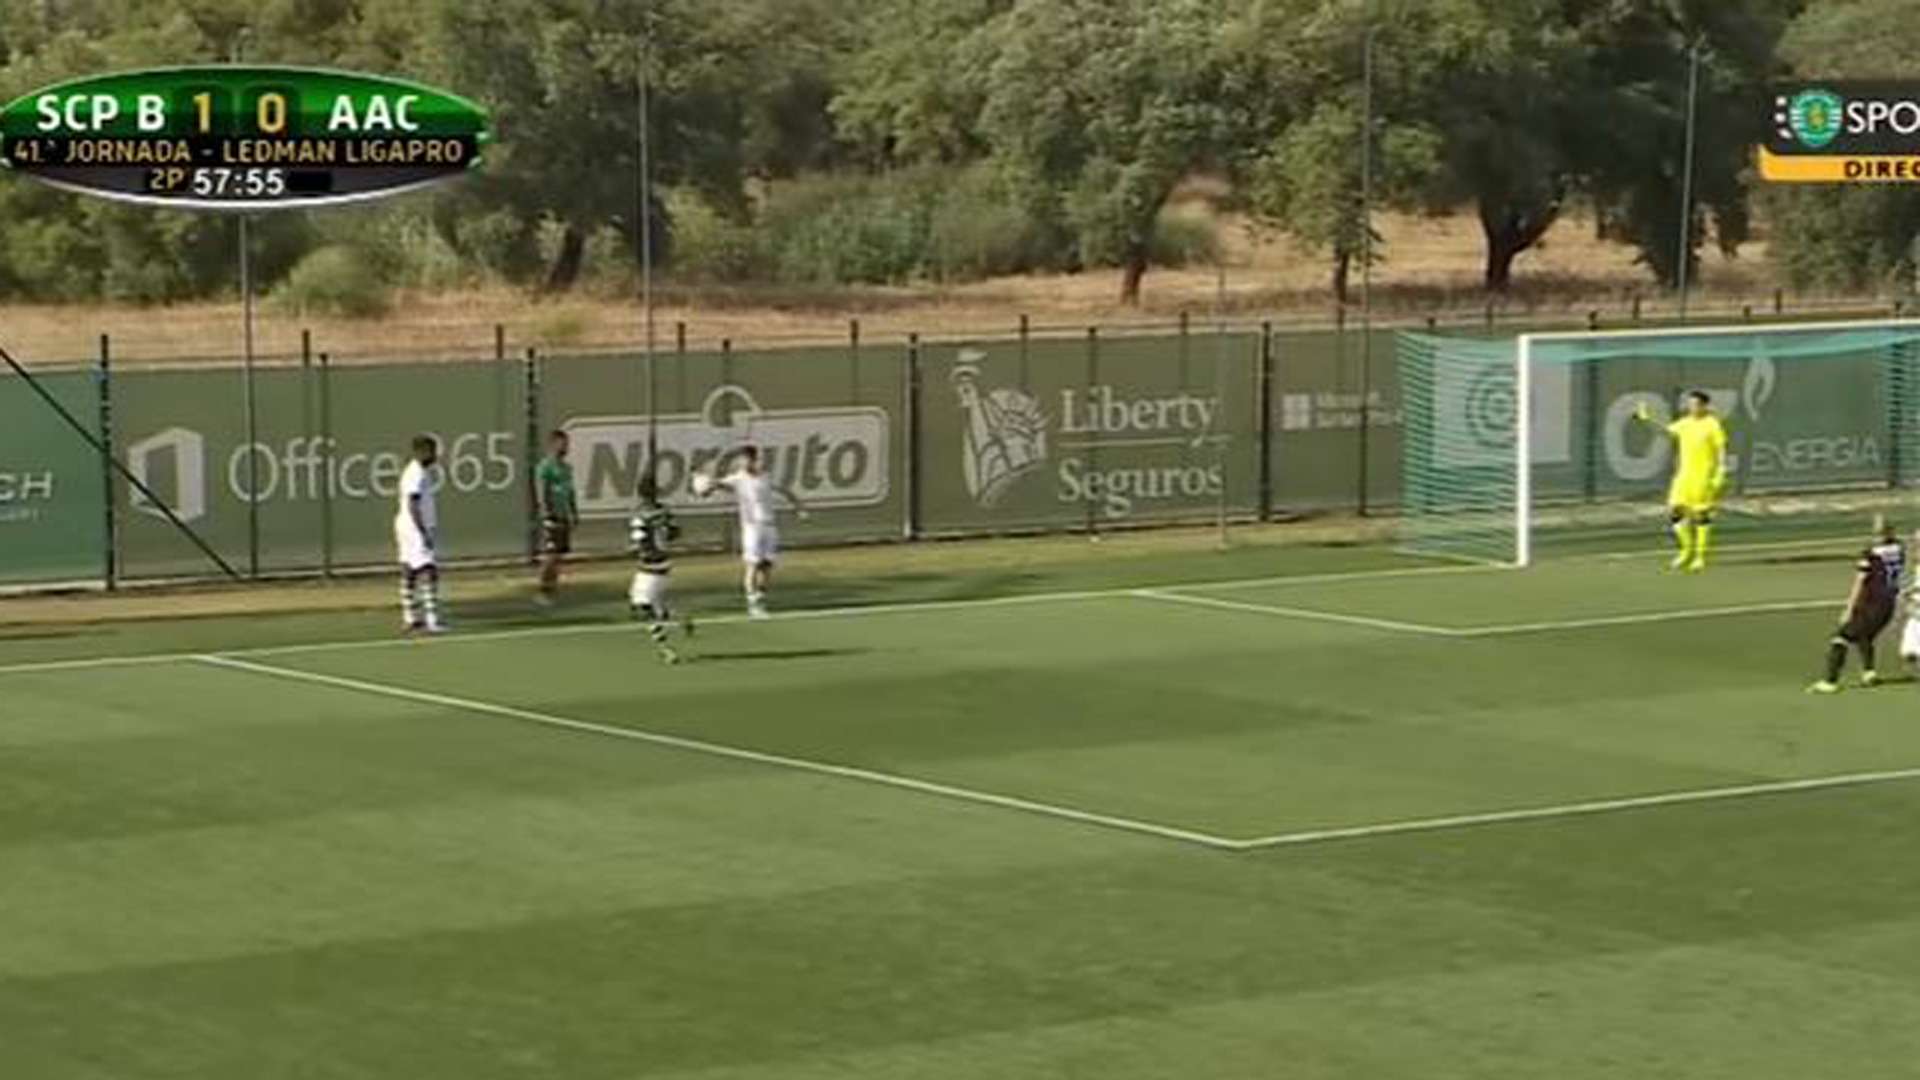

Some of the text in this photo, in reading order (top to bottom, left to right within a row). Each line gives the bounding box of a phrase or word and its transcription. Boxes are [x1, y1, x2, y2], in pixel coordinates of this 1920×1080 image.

[1058, 385, 1220, 448] Liberty
[228, 436, 401, 503] Office
[1751, 434, 1882, 472] ENERGIA
[1057, 457, 1224, 519] Seguros
